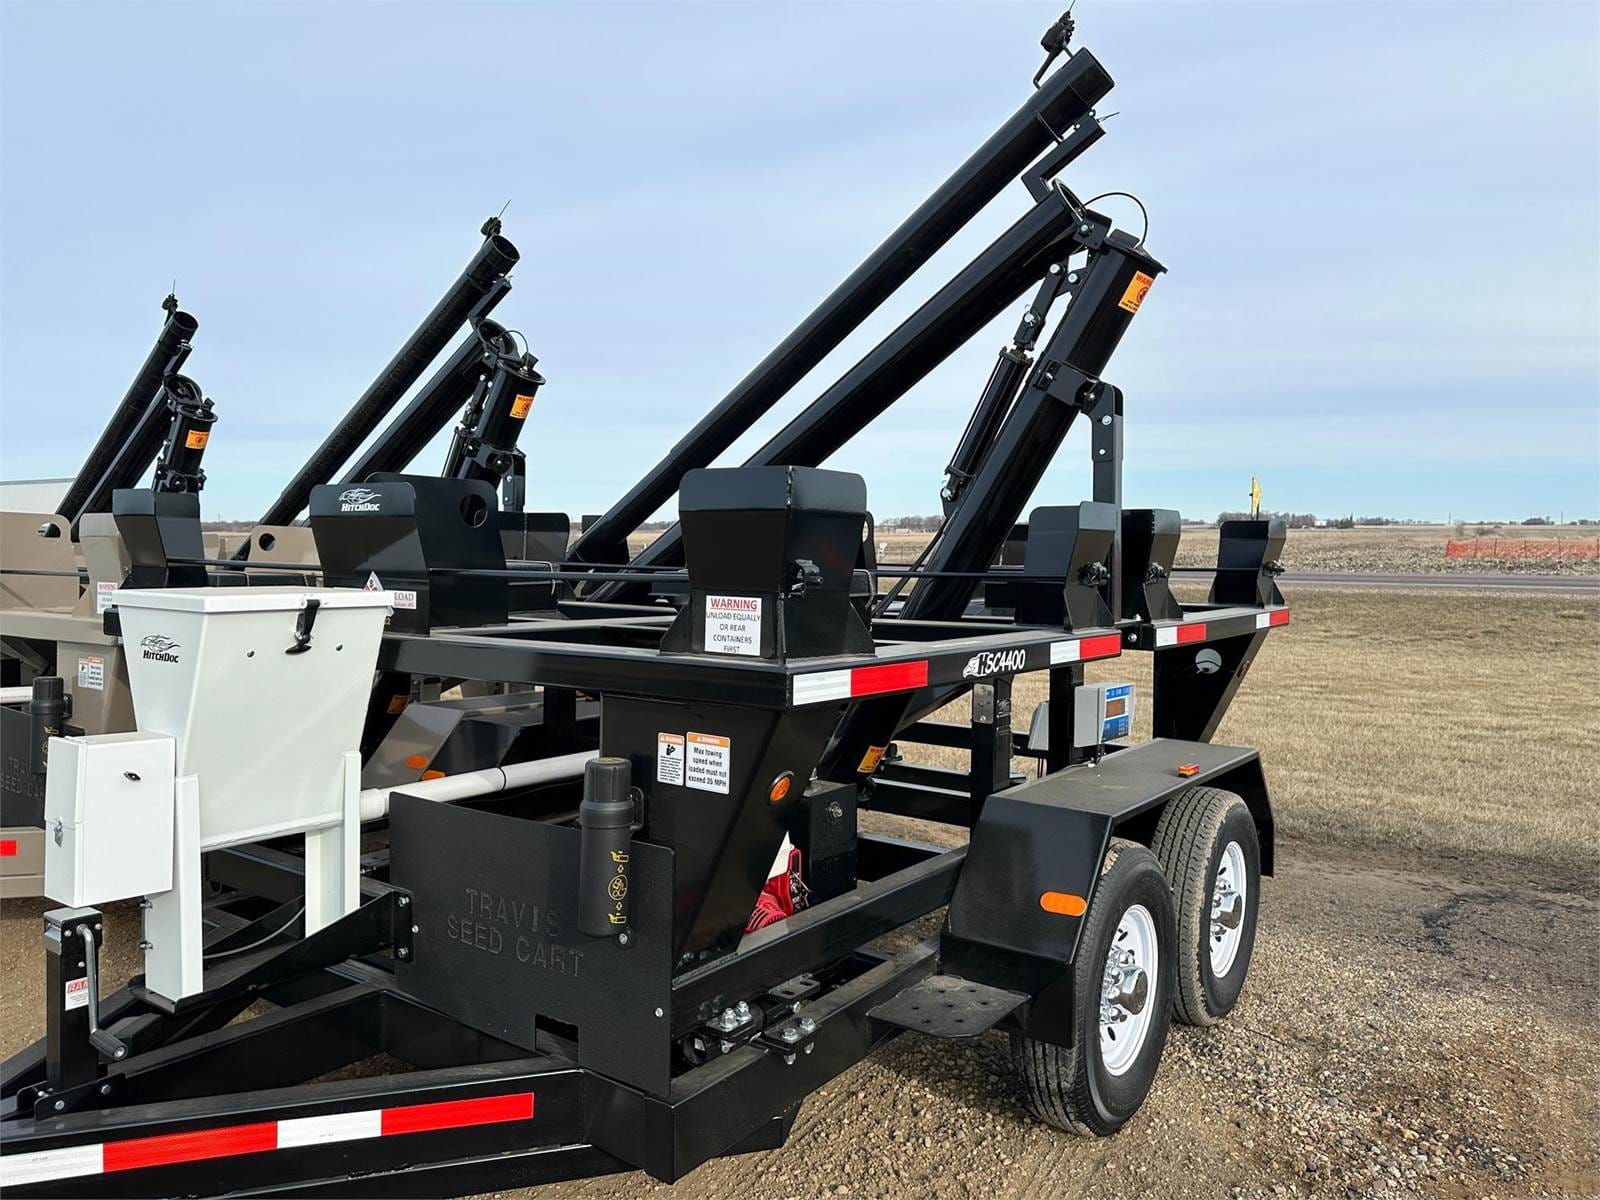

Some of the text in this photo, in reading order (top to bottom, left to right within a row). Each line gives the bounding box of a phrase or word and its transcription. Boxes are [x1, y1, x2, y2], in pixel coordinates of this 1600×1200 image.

[710, 598, 758, 610] WARNING
[706, 612, 761, 622] UNLOAD EQUALLY
[713, 634, 753, 644] CONTAINERS
[723, 645, 740, 653] FIRST
[694, 747, 722, 759] Max towing
[709, 759, 722, 767] when
[688, 765, 705, 774] loaded
[705, 769, 718, 777] must
[688, 776, 726, 787] exceed 35 MPH
[465, 887, 560, 937] TRAVIS
[447, 913, 585, 977] SEED CART
